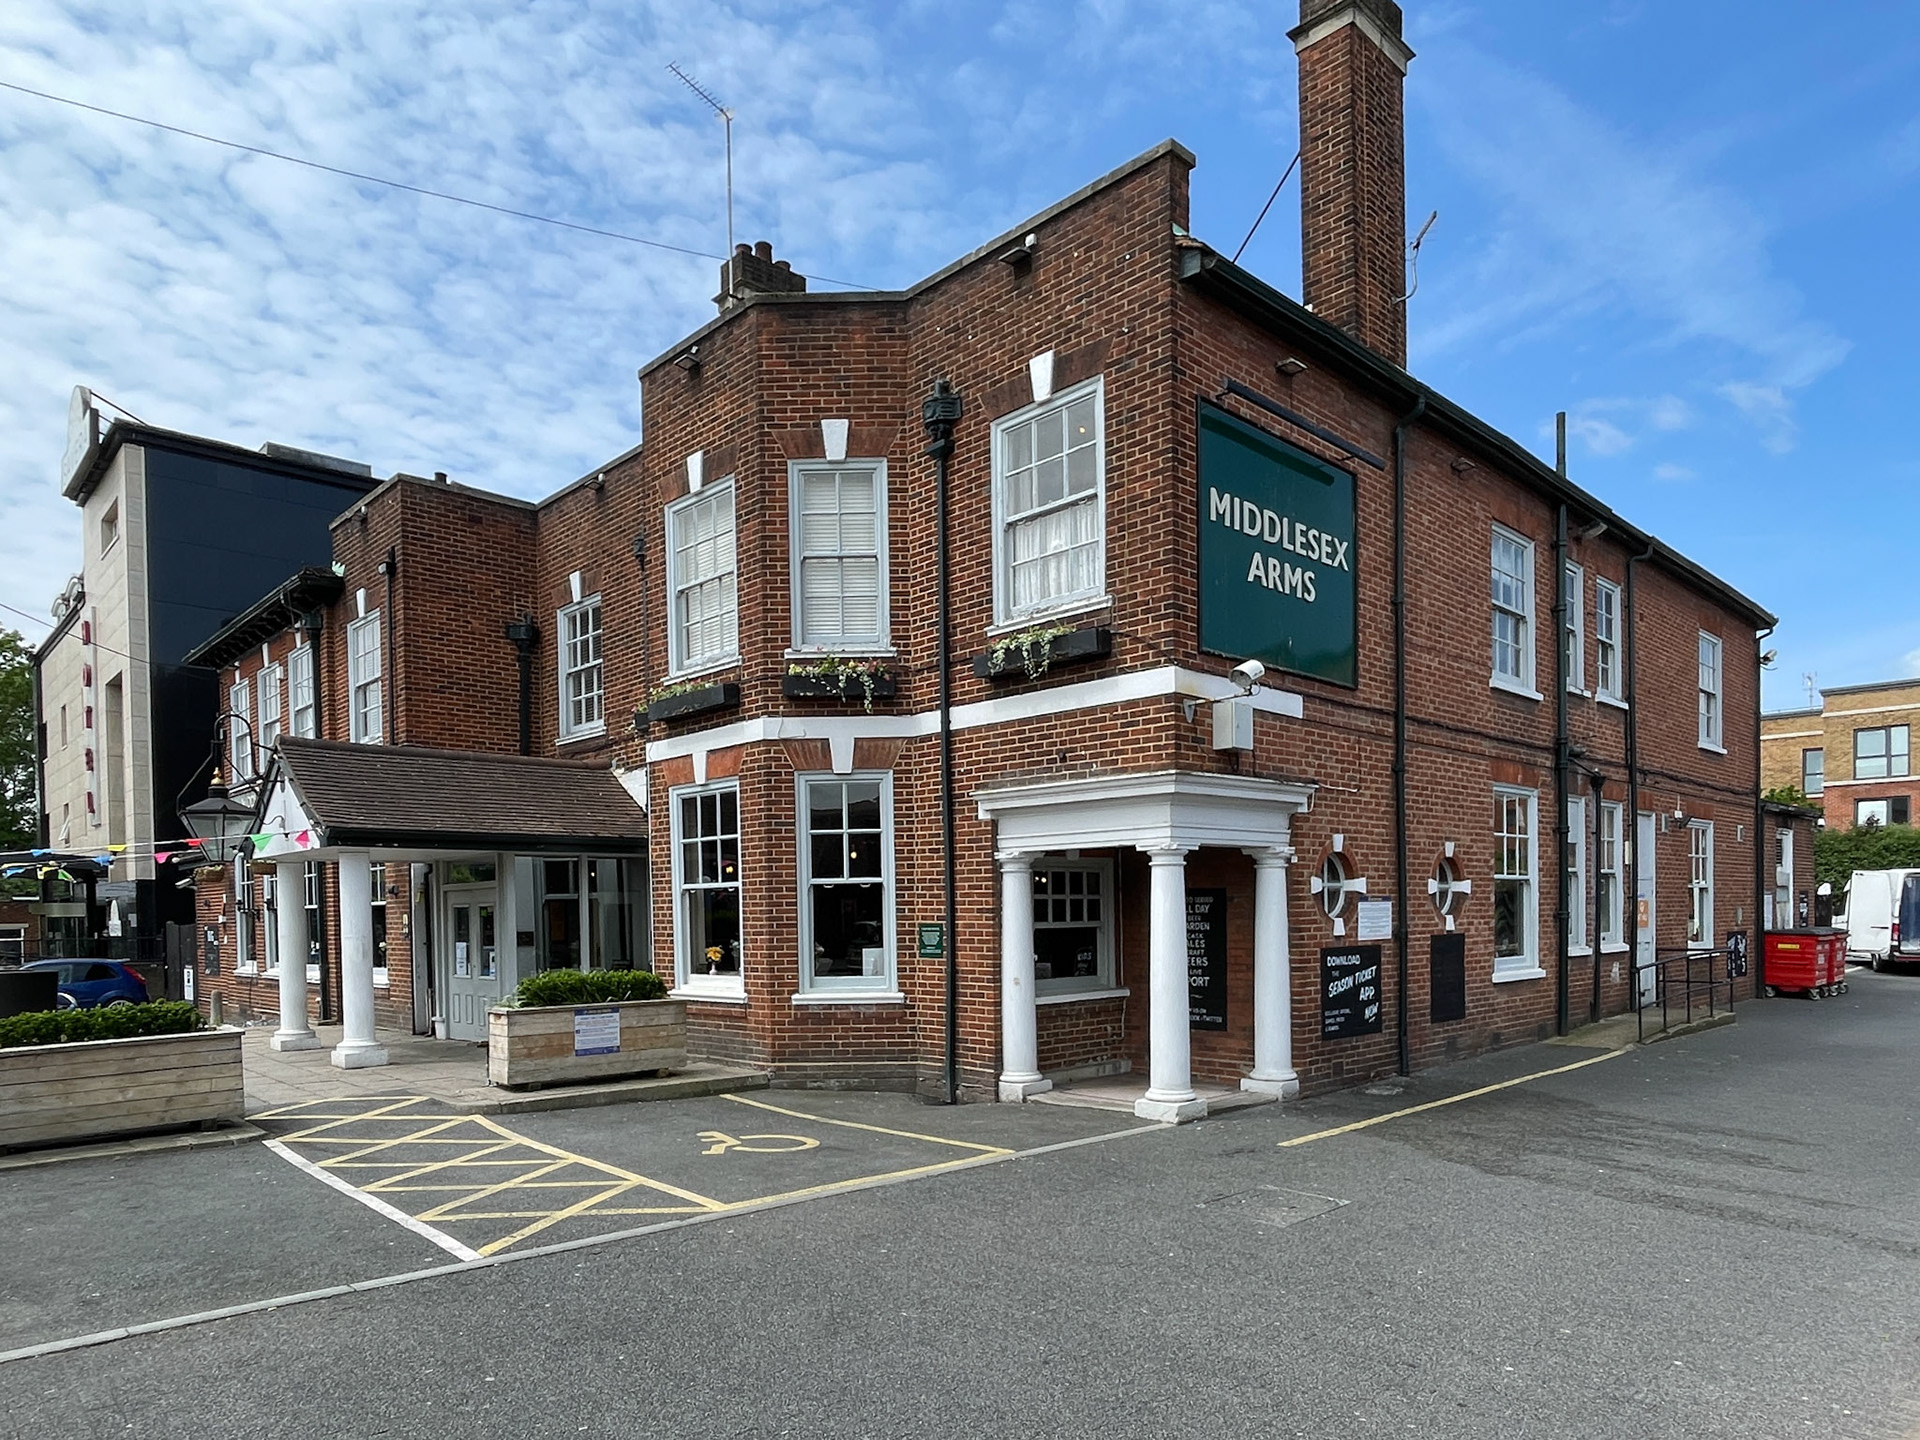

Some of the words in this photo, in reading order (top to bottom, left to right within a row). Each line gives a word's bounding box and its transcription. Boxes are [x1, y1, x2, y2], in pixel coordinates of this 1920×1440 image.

[1209, 486, 1350, 572] MIDDLESEX
[1247, 551, 1316, 603] ARMS
[1195, 904, 1210, 913] DAY
[1186, 922, 1210, 930] ARDEN
[1188, 956, 1208, 966] EERS
[1327, 955, 1361, 966] DOWNLOAD
[1188, 976, 1210, 987] PORT
[1328, 976, 1354, 998] SEASON
[1355, 964, 1377, 985] TICKET
